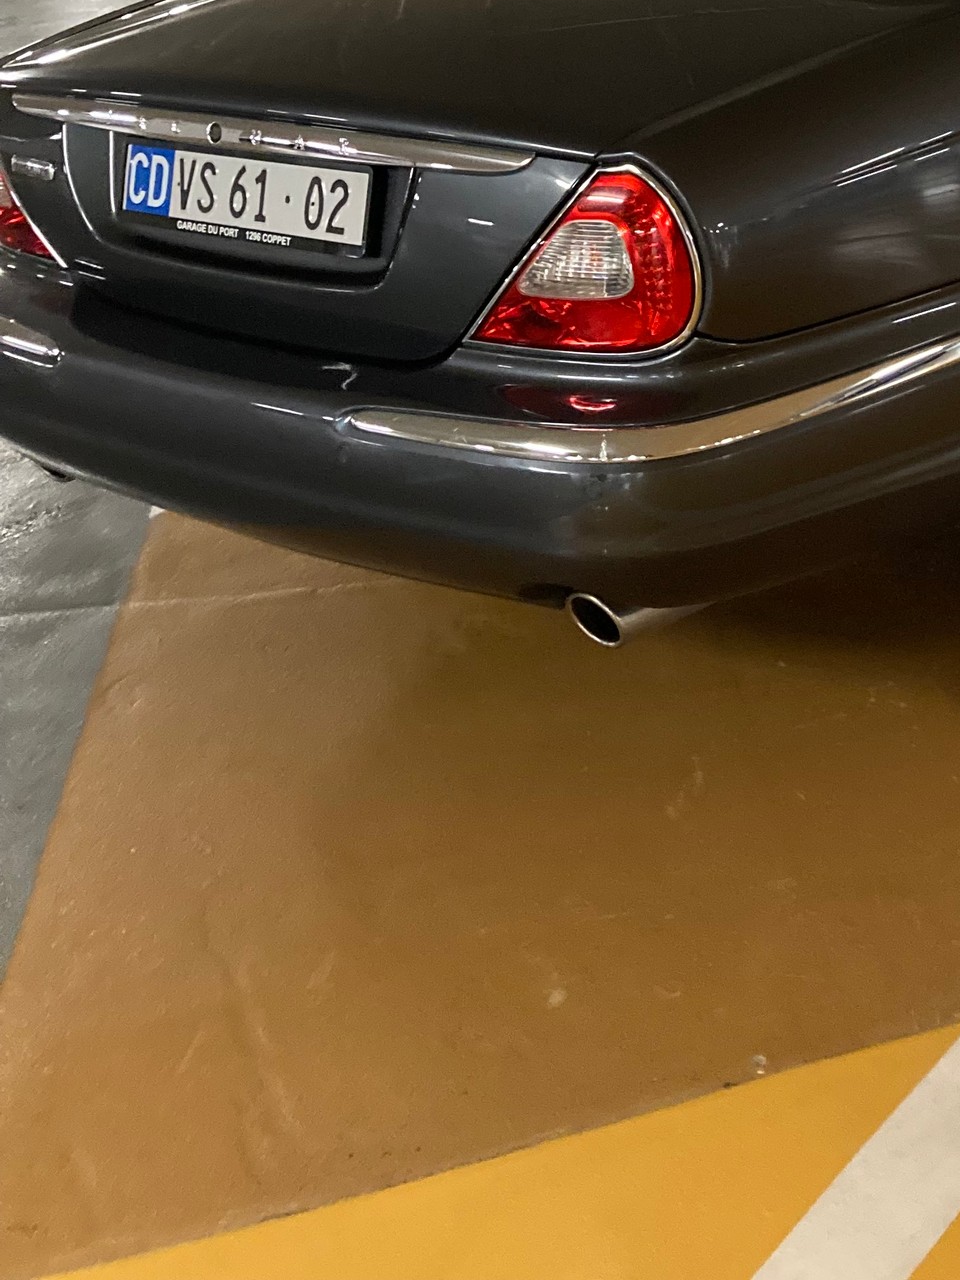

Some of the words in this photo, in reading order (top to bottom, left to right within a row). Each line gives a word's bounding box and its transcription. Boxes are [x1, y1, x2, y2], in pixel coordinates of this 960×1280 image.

[129, 152, 170, 208] CD
[179, 158, 216, 213] VS
[229, 165, 267, 223] 61
[304, 176, 349, 235] 02
[176, 220, 207, 233] GARAGE
[207, 225, 219, 235] DU
[219, 227, 240, 238] PORT
[245, 230, 261, 242] 1296
[261, 233, 292, 247] COPPET
